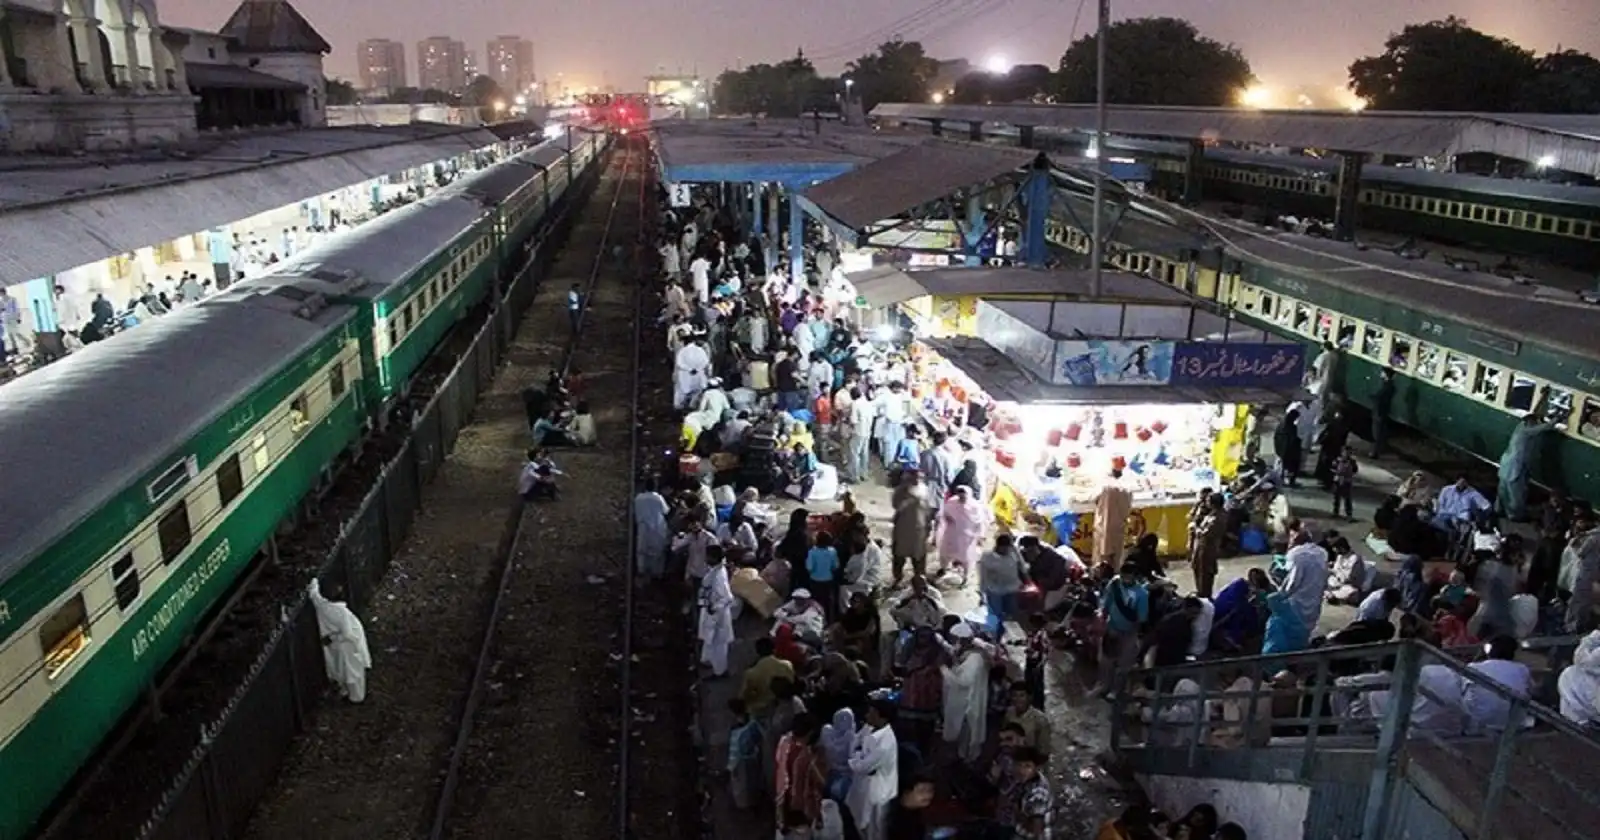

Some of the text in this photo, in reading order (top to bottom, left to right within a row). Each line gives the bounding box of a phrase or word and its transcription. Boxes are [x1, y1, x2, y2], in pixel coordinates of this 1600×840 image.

[1176, 355, 1202, 376] 13
[131, 537, 231, 662] AIR CONDITIONED SLEEPER
